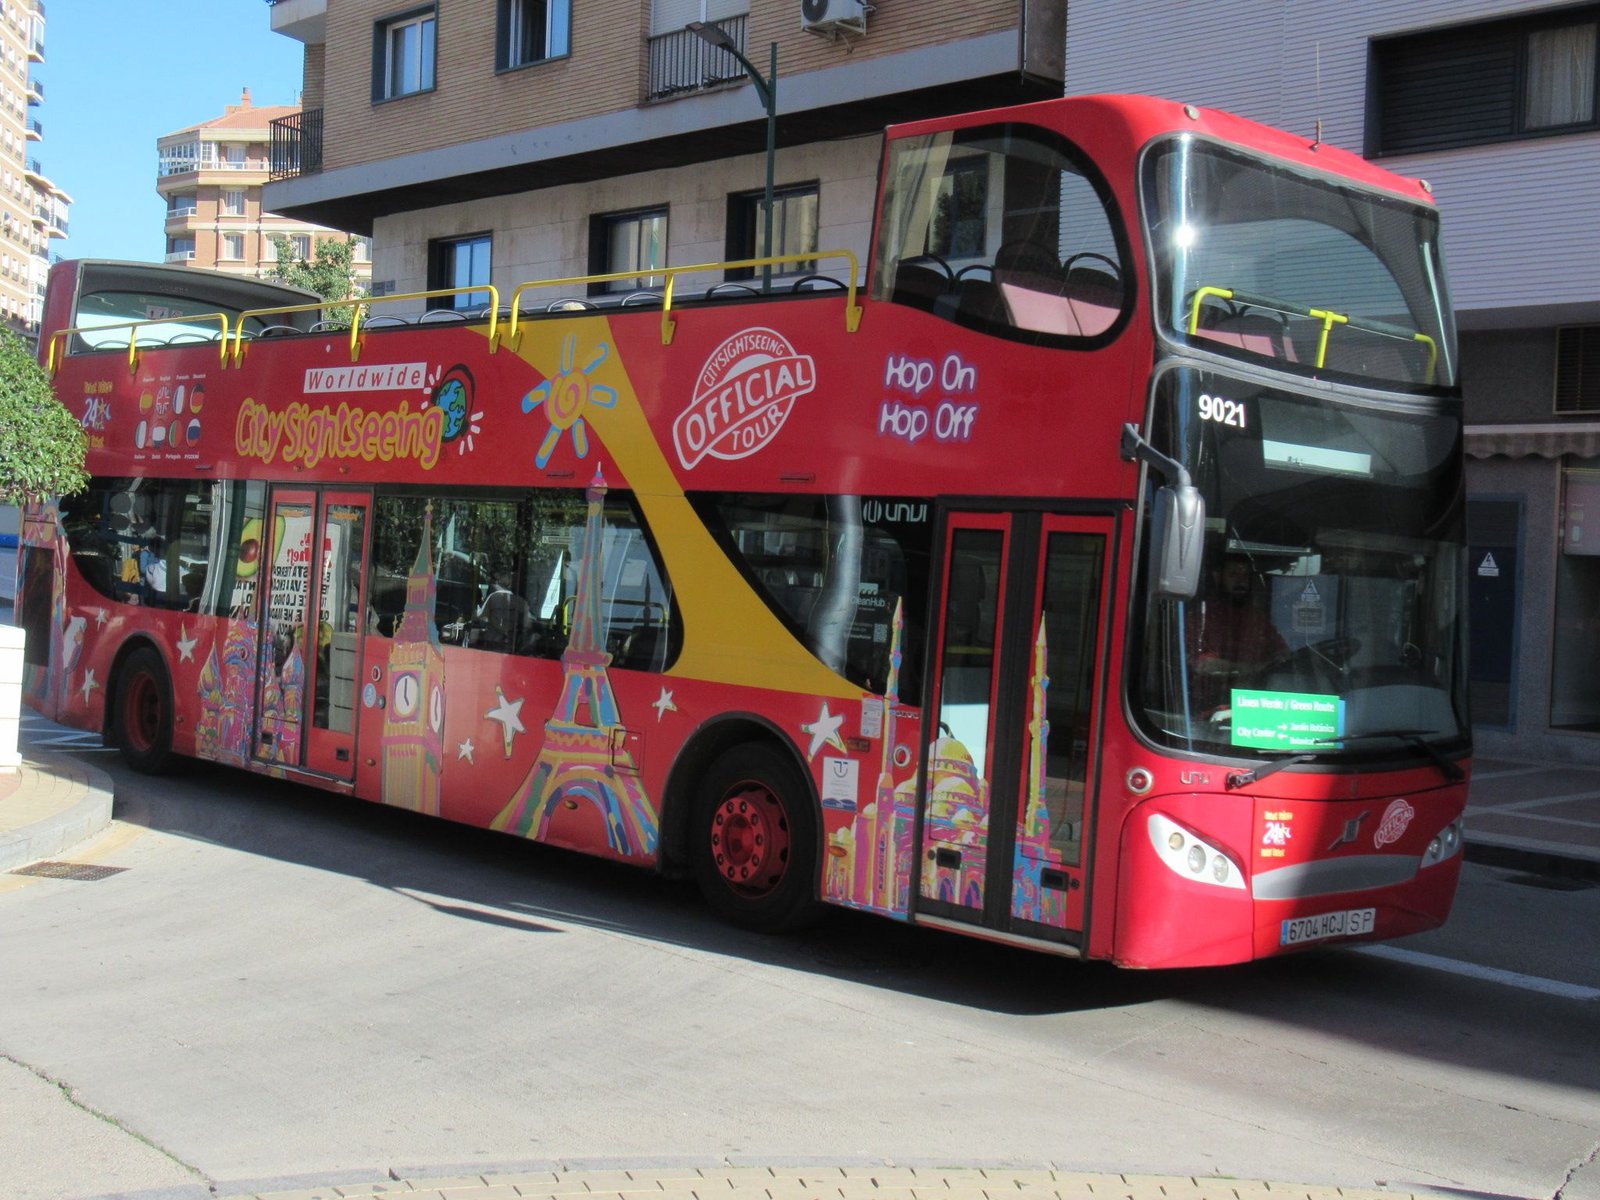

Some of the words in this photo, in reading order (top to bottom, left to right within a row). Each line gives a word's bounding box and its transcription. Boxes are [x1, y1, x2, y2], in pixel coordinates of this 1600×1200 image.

[308, 366, 421, 390] Worldwide
[885, 356, 934, 394] Hop
[942, 354, 976, 391] On
[685, 361, 811, 451] OFFICIAL
[880, 403, 928, 441] Hop
[935, 402, 978, 439] Off
[1198, 394, 1246, 428] 9021
[731, 404, 784, 451] TOUR
[1377, 808, 1413, 843] OFFICIAL
[1289, 916, 1319, 940] 6704
[1321, 912, 1345, 935] HCJ
[1350, 910, 1373, 932] SP
